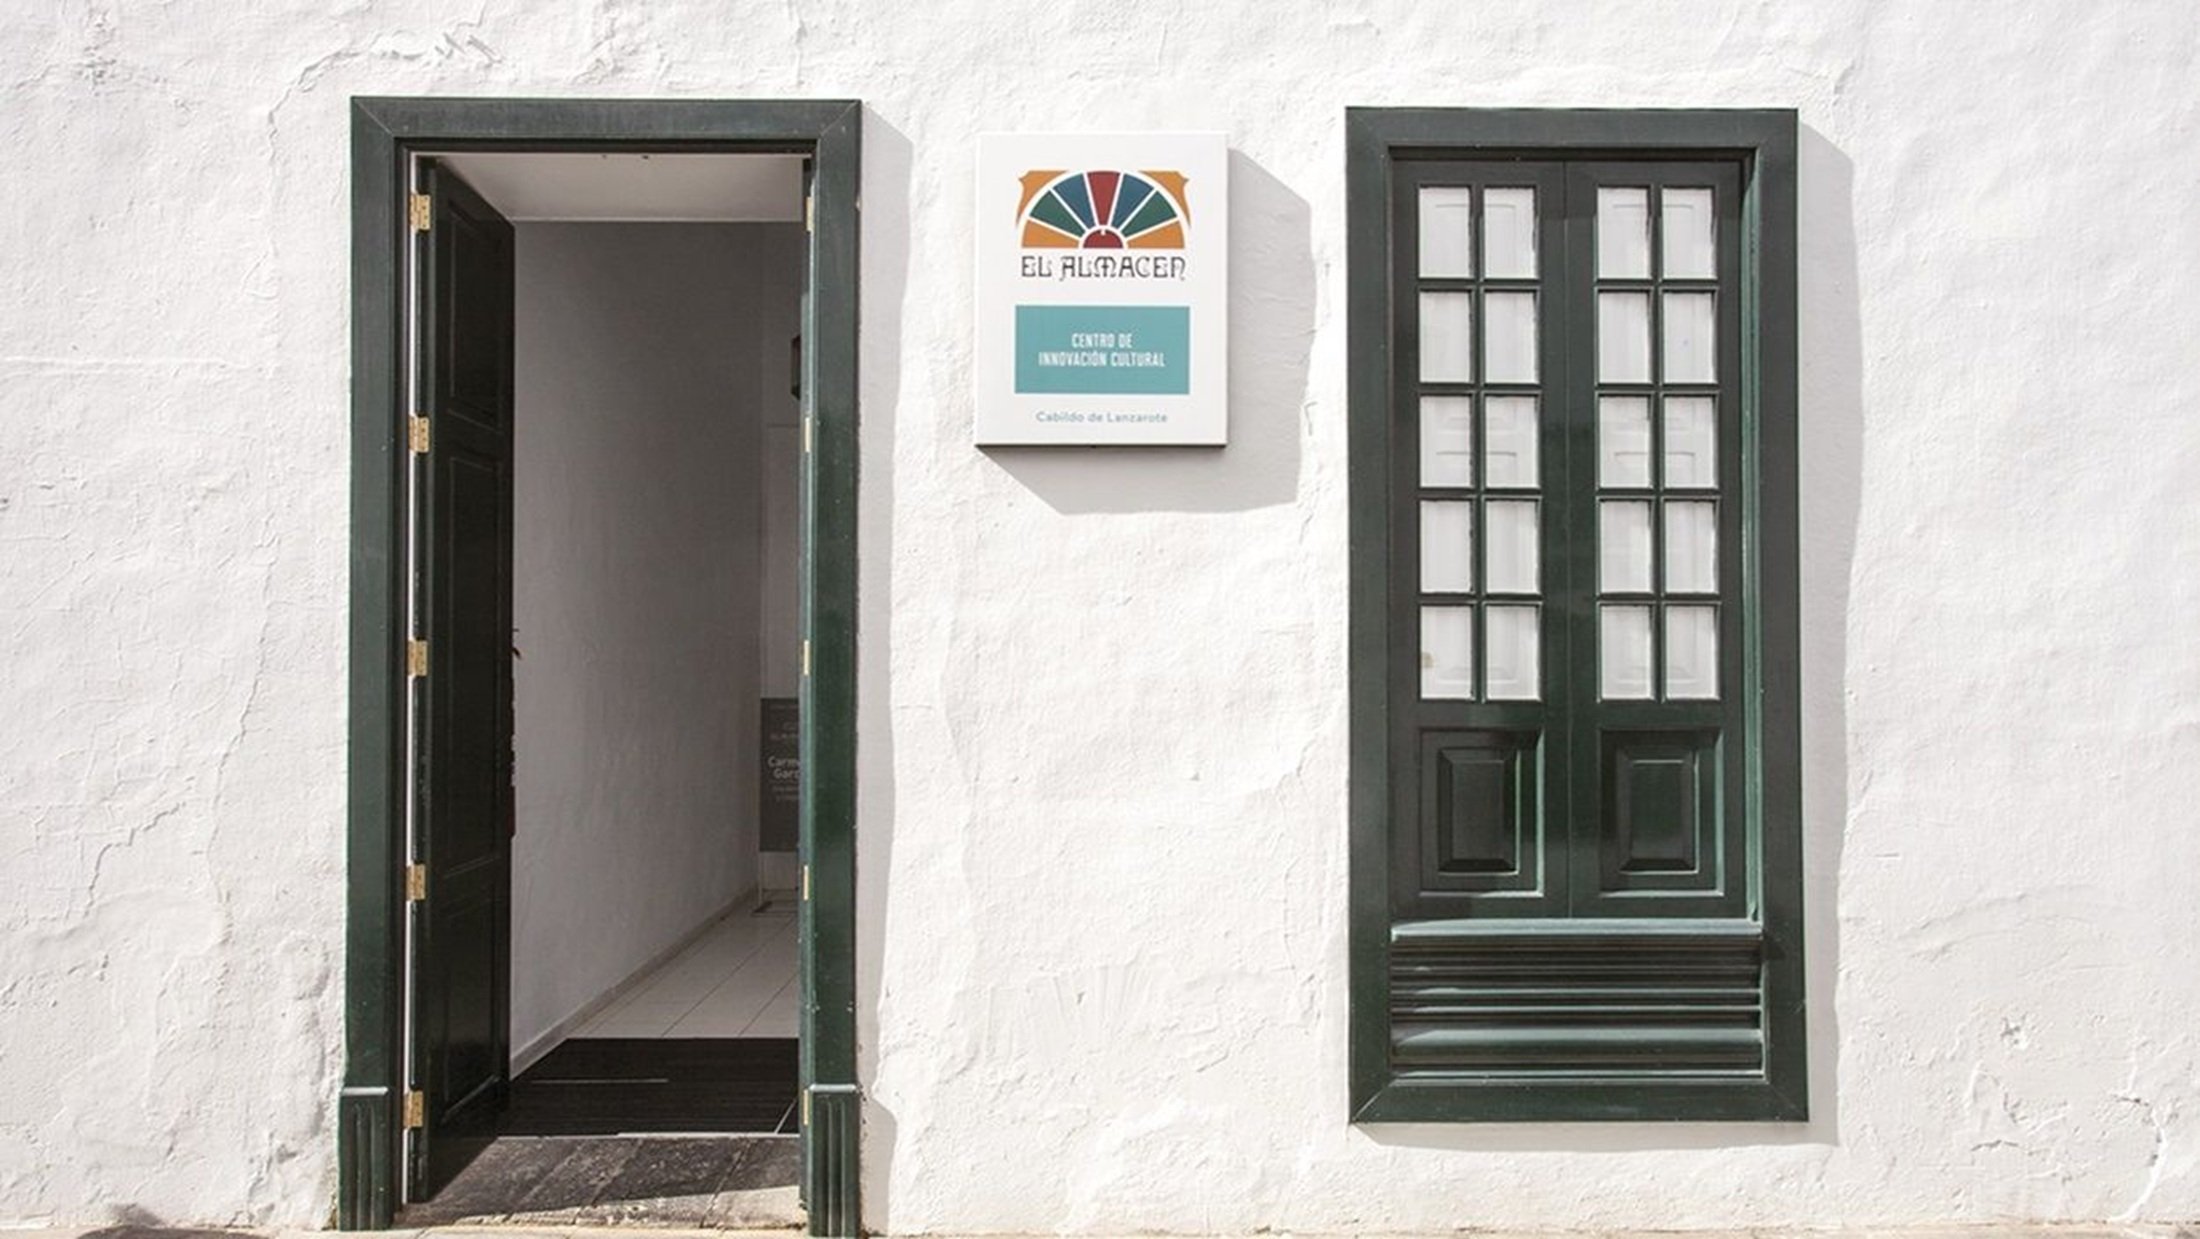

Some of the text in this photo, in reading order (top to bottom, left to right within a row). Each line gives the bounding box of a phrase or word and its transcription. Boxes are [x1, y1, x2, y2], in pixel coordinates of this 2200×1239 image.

[1021, 256, 1186, 281] EL ALMACEN
[1071, 333, 1133, 348] CENTRO DE
[1038, 350, 1166, 367] INNOVACIÓN CULTURAL
[1036, 410, 1168, 424] Cabildo de Lanzarote
